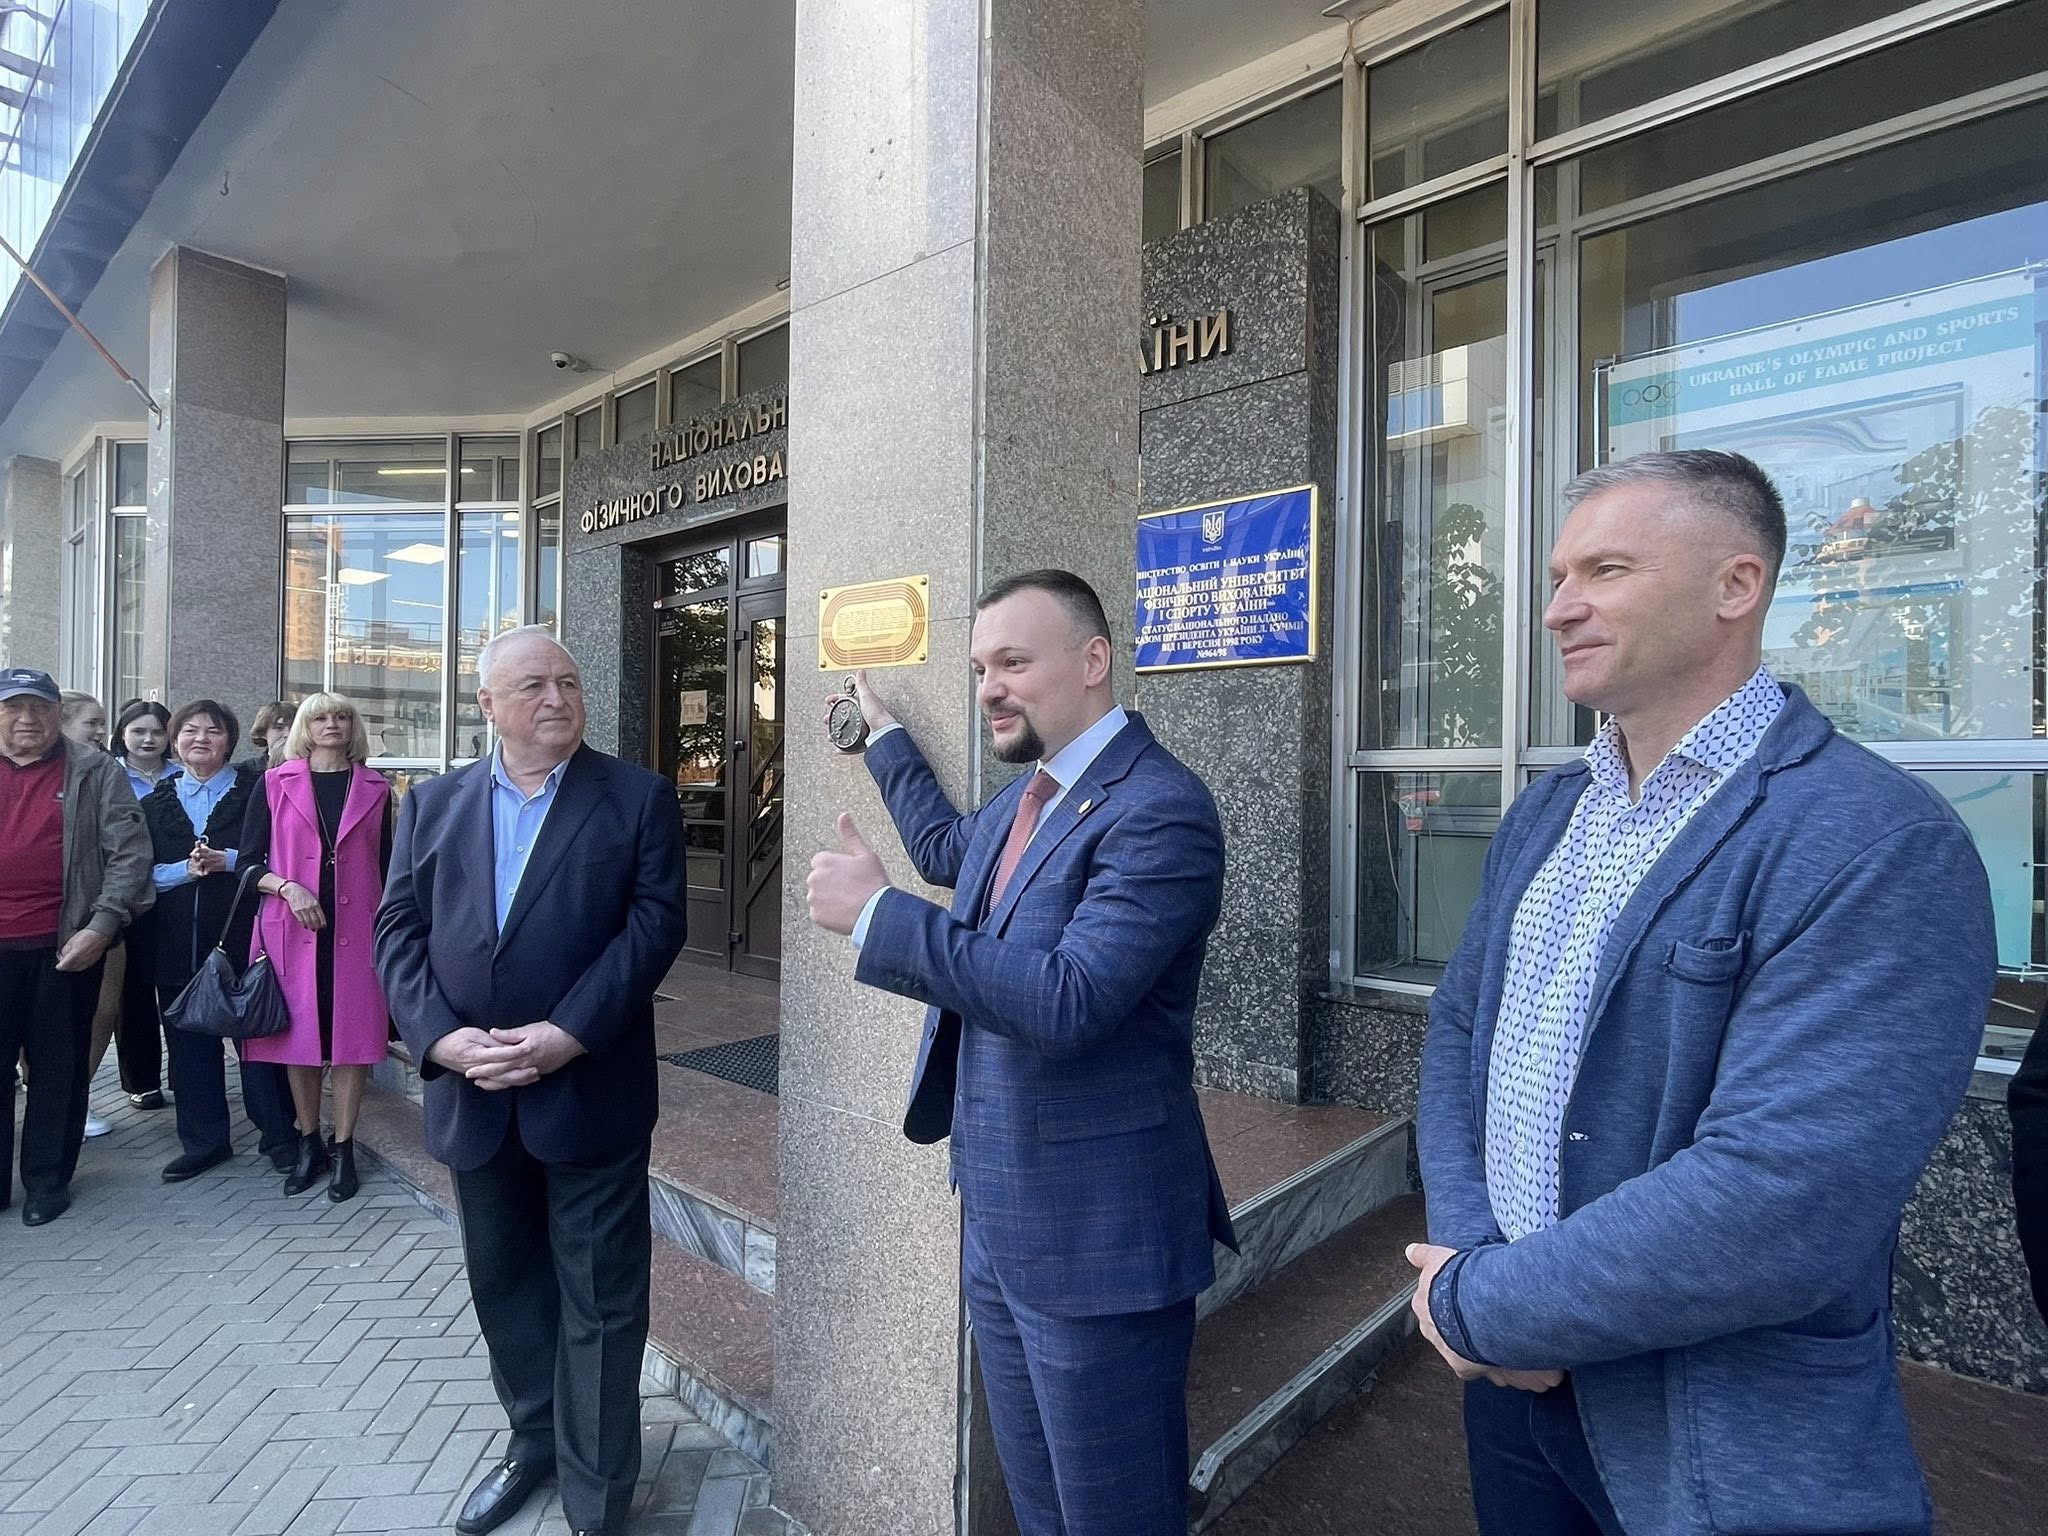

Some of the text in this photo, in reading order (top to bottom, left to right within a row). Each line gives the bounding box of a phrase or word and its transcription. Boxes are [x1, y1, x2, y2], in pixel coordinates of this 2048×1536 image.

[1689, 306, 2019, 387] UKRAINE'S OLYMPIC AND SPORTS
[1729, 337, 1967, 397] HALL OF FAME PROJECT
[651, 395, 788, 470] НАЦІОНАЛЬН
[581, 450, 785, 534] ФІЗИЧНОГО ВИХОВА
[1136, 565, 1187, 580] ІНІСТЕРСТВО
[1189, 560, 1220, 573] ОСВІТИ
[1230, 555, 1261, 567] НАУКИ
[1137, 567, 1307, 599] АЦІОНАЛЬНИЙ УНІВЕРСИТЕТ
[1143, 583, 1287, 611] ФІЗИЧНОГО ВИХОВАННЯ
[1166, 604, 1211, 620] СПОРТУ
[1135, 634, 1161, 645] КАЗОМ
[1141, 623, 1173, 635] СТАТУС
